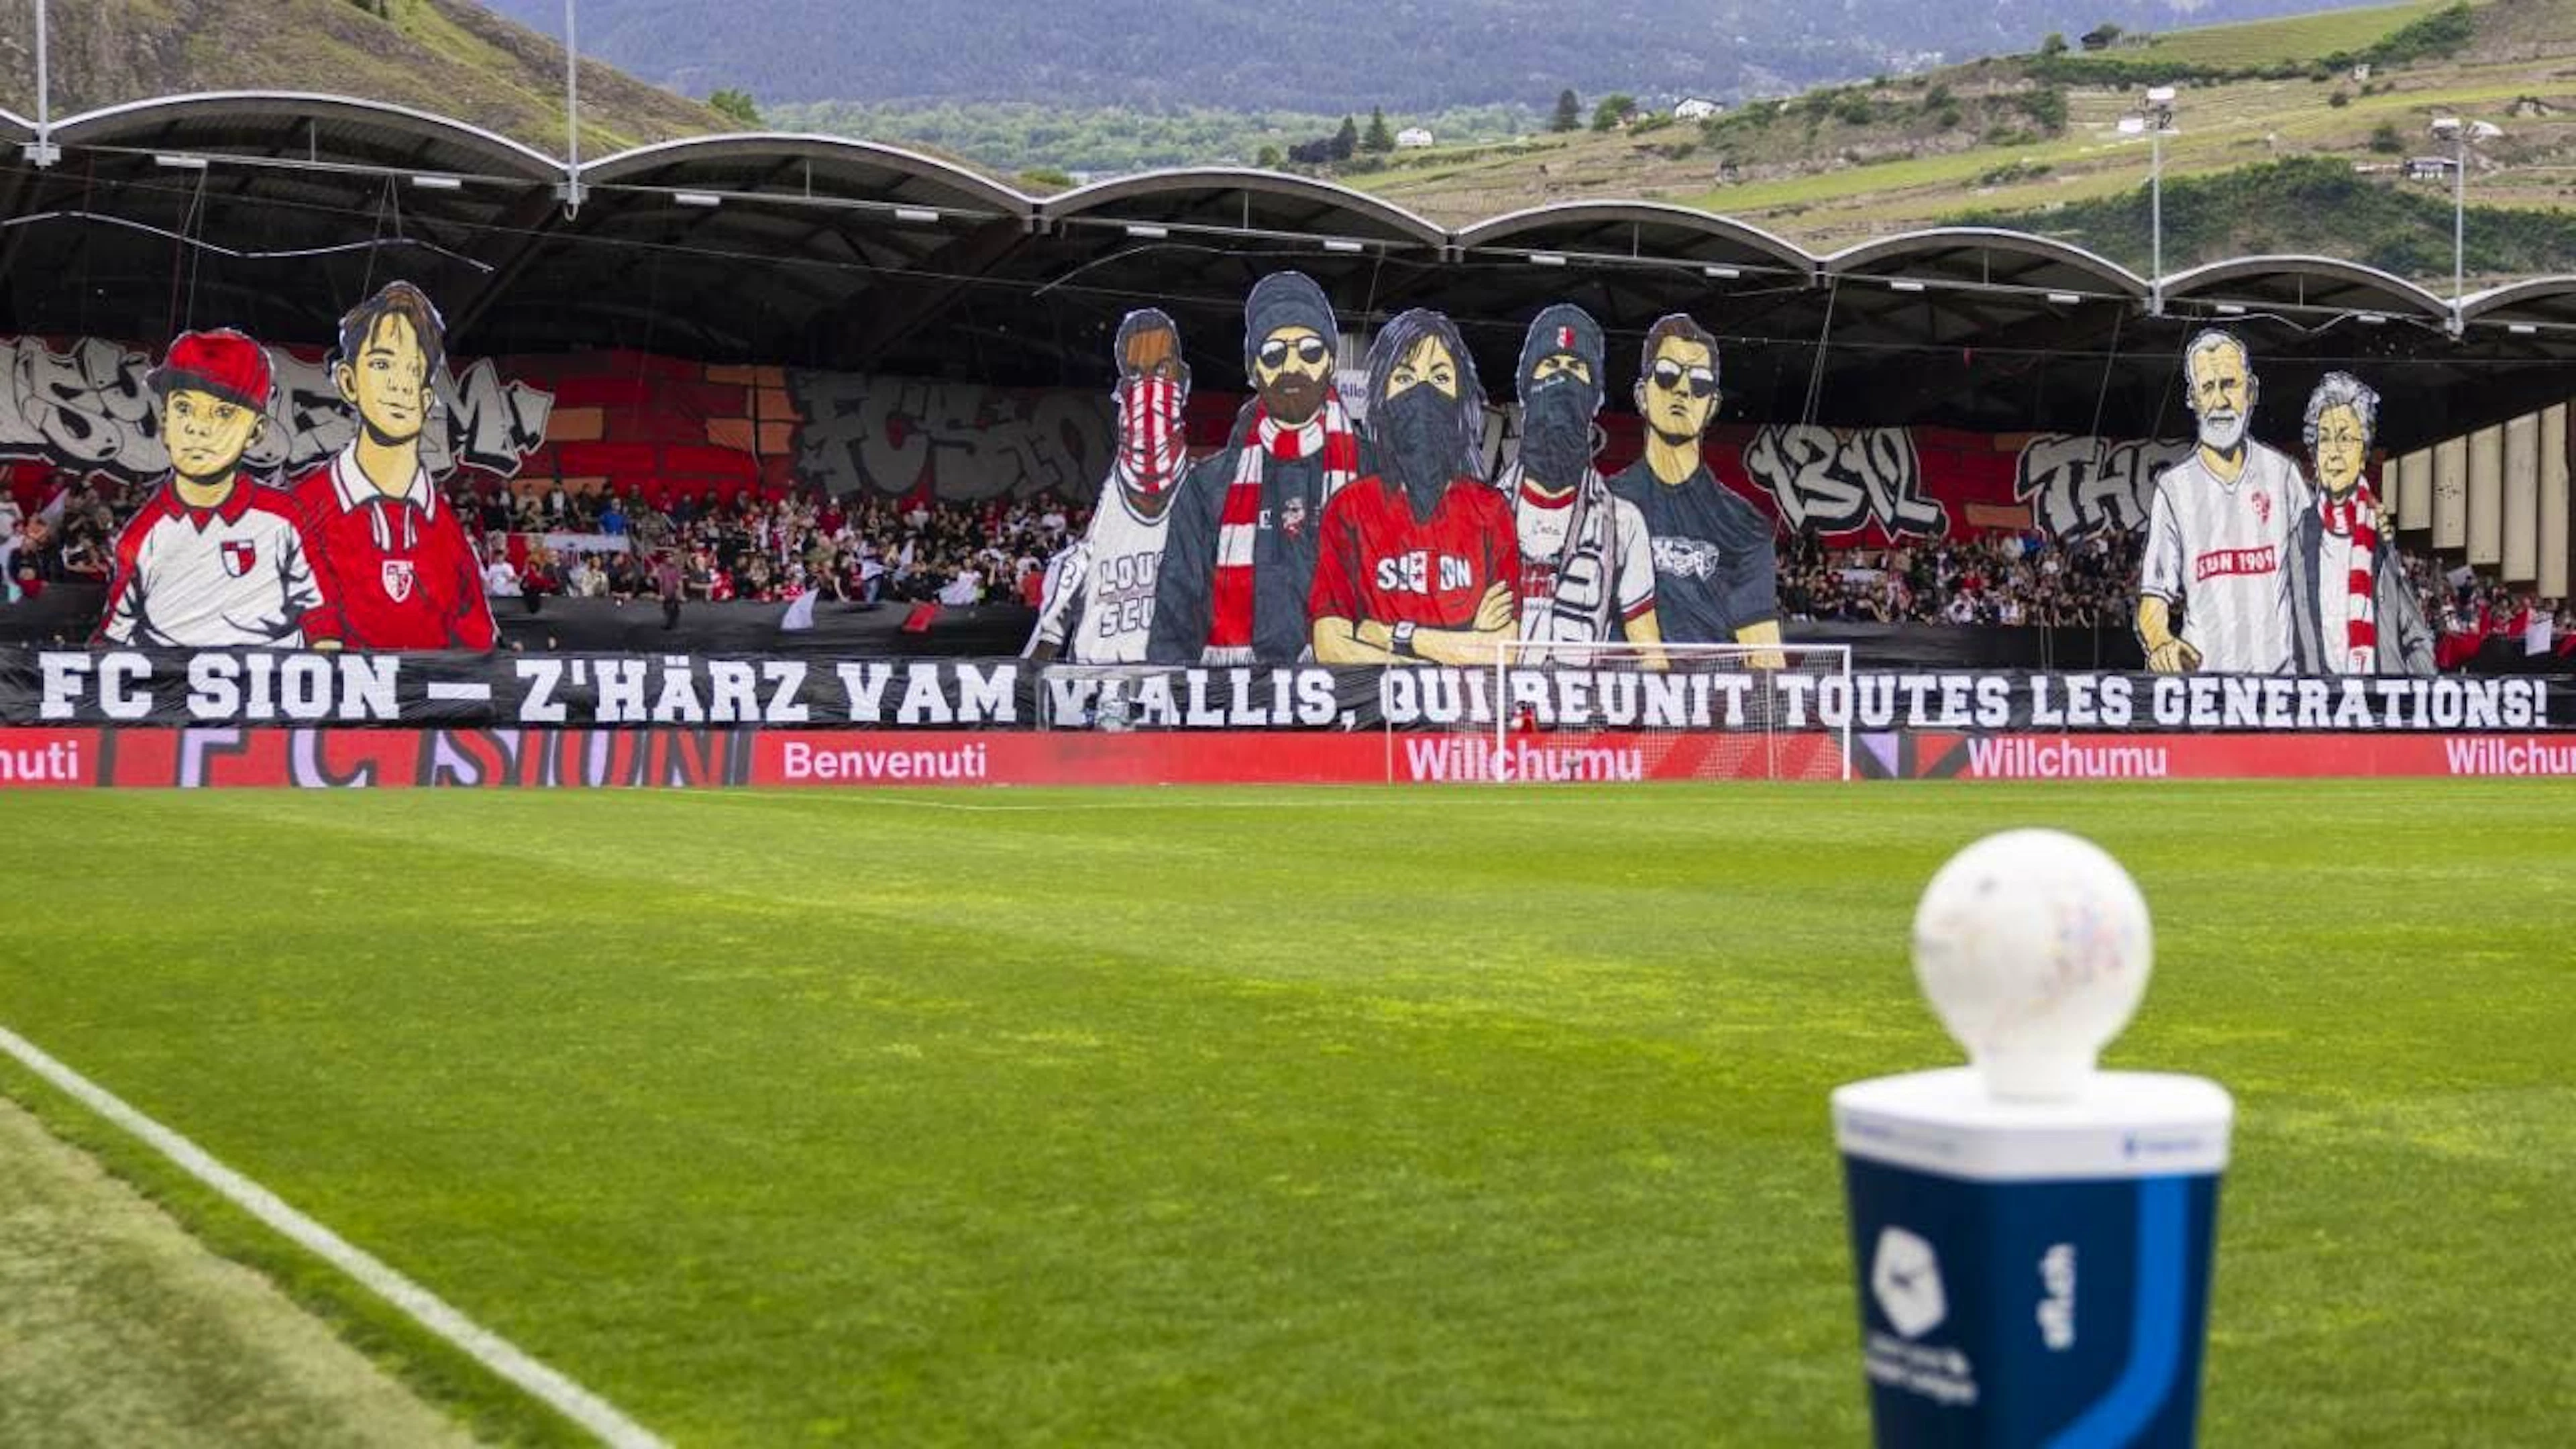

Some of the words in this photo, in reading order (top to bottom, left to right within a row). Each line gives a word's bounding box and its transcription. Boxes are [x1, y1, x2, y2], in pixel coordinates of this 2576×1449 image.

[38, 651, 152, 719] FC
[186, 653, 400, 719] SION
[516, 655, 808, 722] Z'HÄRZ
[837, 663, 1018, 723] VAM
[1380, 669, 1491, 724] QUI
[1510, 670, 1753, 727] REUNIT
[1776, 674, 2010, 727] TOUTES
[2030, 675, 2133, 727] LES
[2153, 676, 2548, 728] GENERATIONS!
[784, 741, 986, 778] Benvenuti
[1405, 739, 1642, 781] Willchumu
[1968, 738, 2167, 777] Willchumu
[2445, 738, 2576, 774] Willchu
